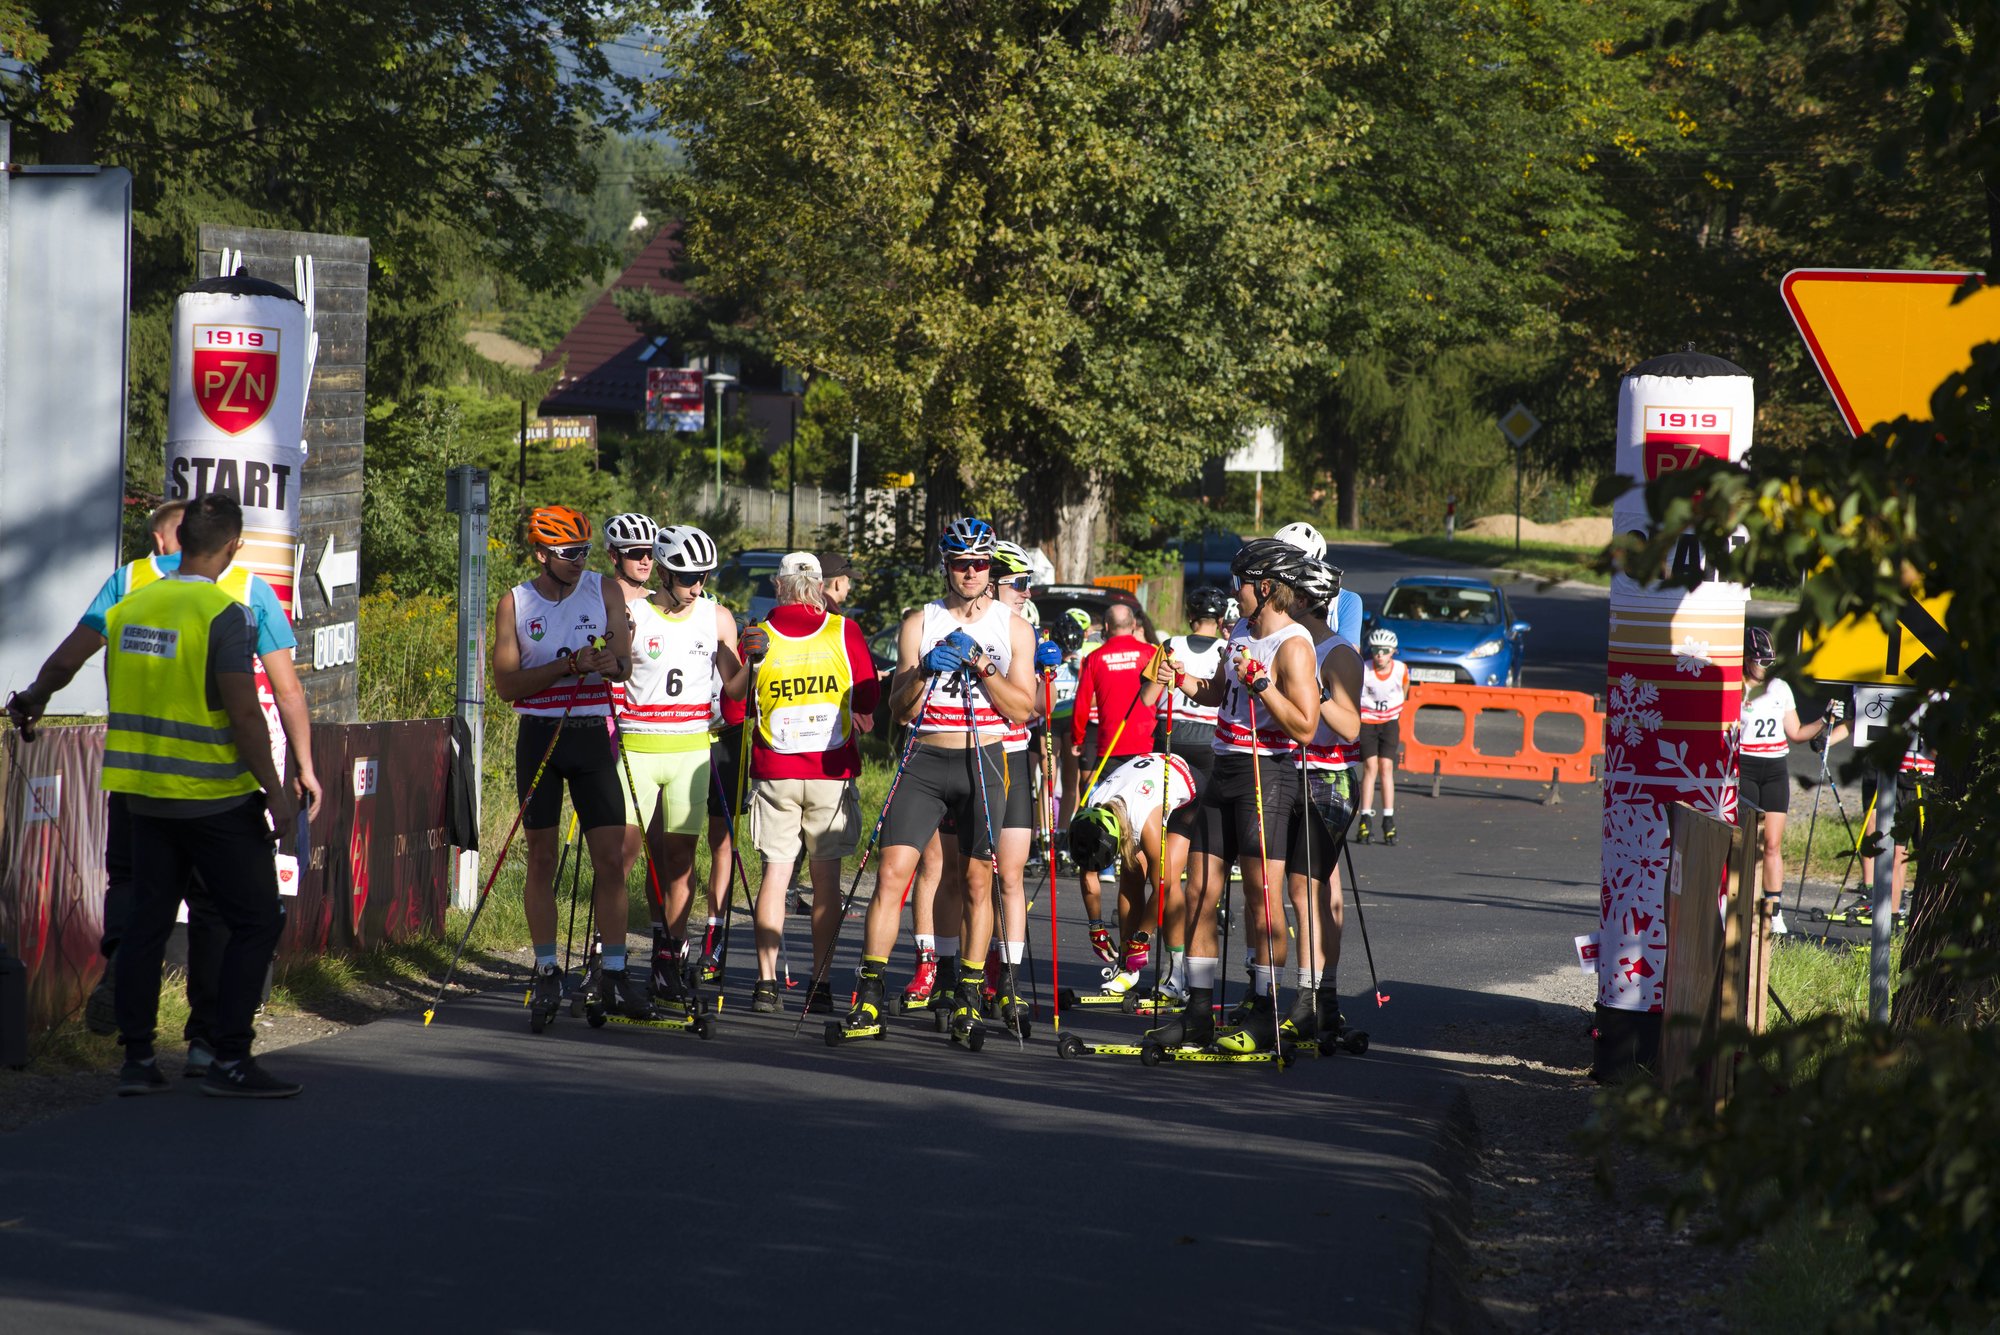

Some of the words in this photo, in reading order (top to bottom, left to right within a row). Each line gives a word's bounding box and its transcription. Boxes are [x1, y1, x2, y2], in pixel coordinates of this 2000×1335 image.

[206, 330, 264, 347] 1919
[204, 360, 266, 413] PZN
[1658, 413, 1717, 428] 1919
[553, 426, 591, 438] POKOJE
[171, 456, 291, 511] START
[1108, 662, 1137, 671] TRENER
[666, 668, 684, 697] 6
[769, 675, 839, 701] SĘDZIA
[1374, 700, 1388, 711] 16
[1754, 718, 1777, 738] 22
[357, 767, 374, 791] 1919
